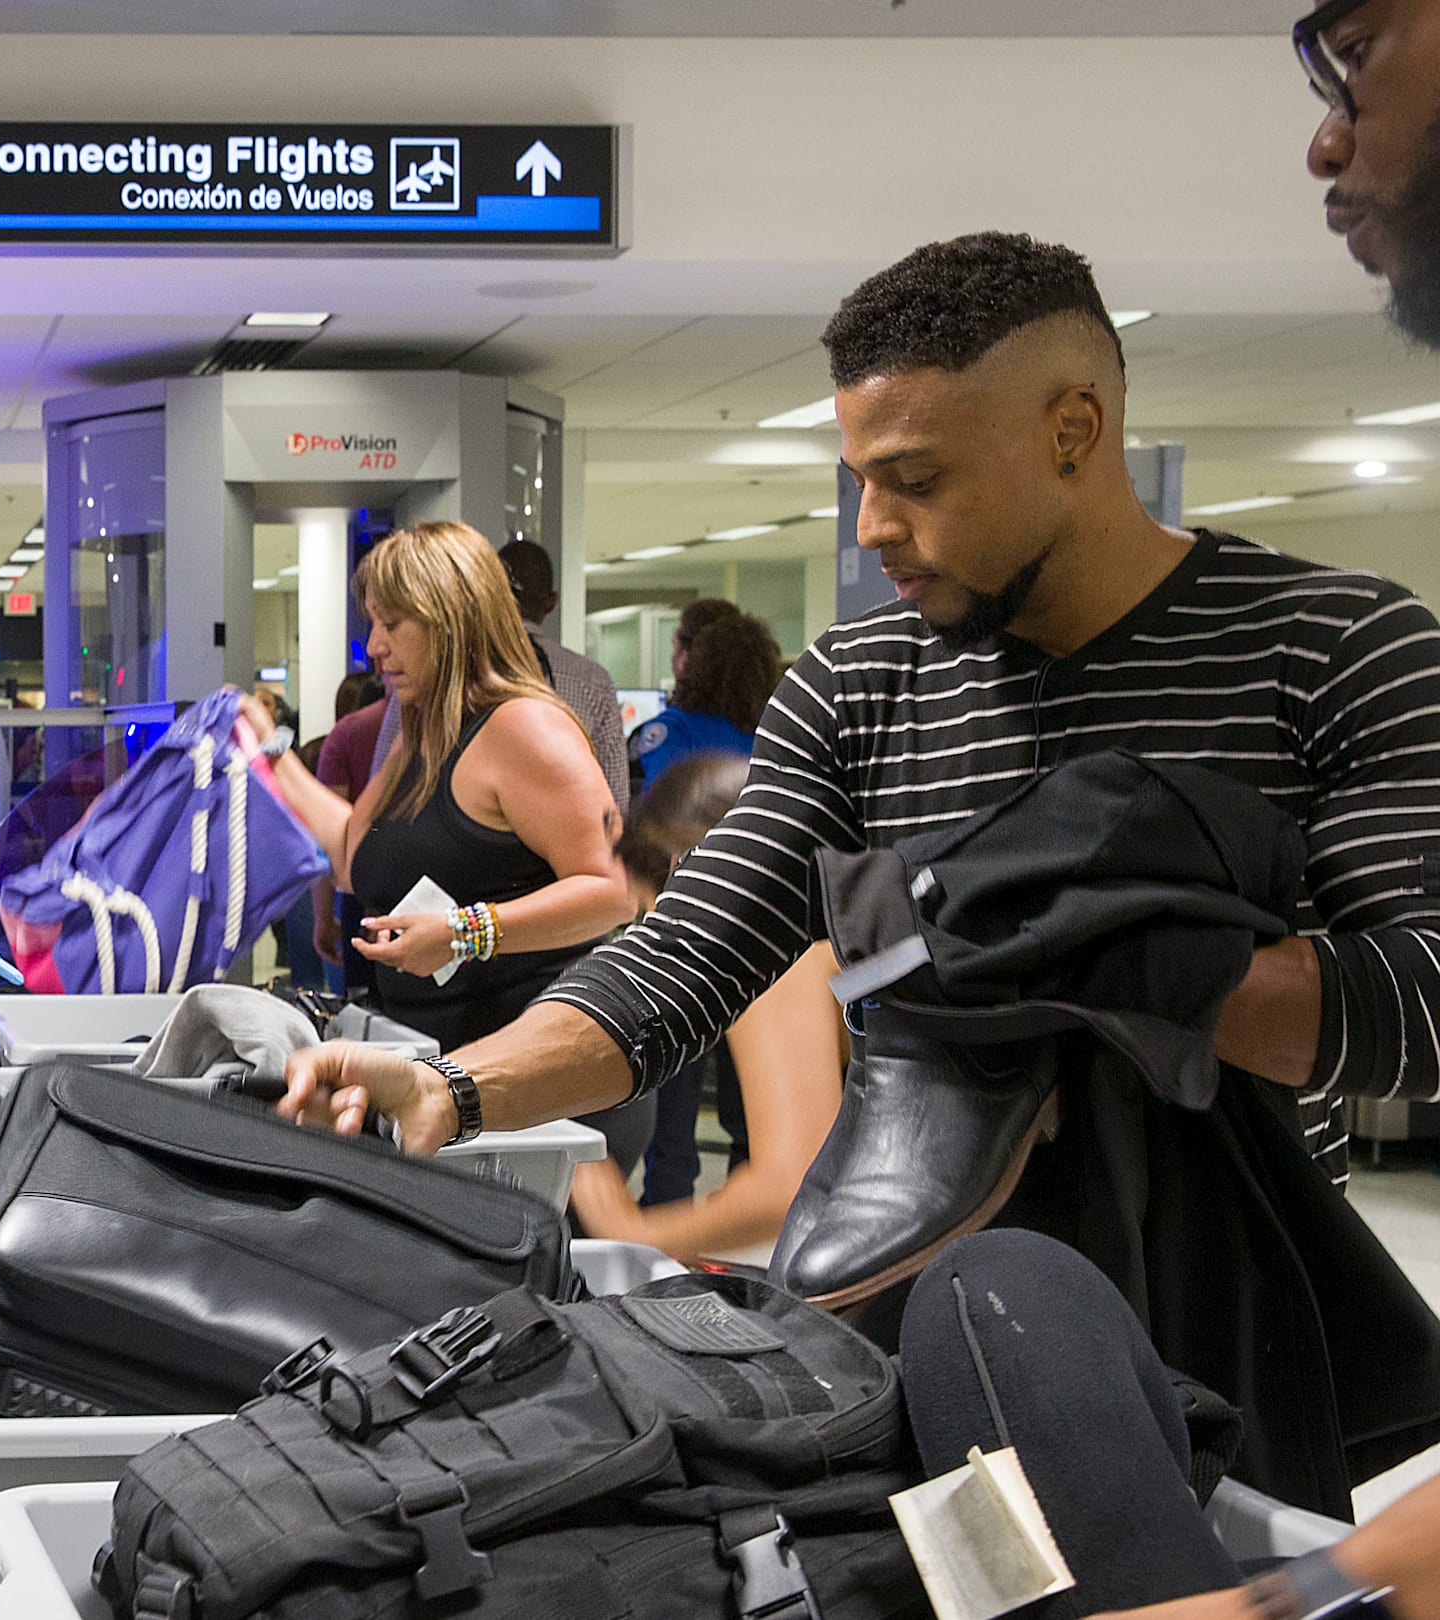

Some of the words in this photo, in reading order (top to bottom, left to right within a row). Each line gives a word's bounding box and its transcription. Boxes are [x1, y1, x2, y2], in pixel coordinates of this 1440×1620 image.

[227, 136, 375, 182] Flights
[121, 182, 242, 210] Conexión
[248, 183, 283, 210] de
[287, 183, 375, 211] Vuelos
[310, 434, 397, 451] ProVision
[359, 452, 397, 469] ATD
[8, 593, 33, 613] EXIT
